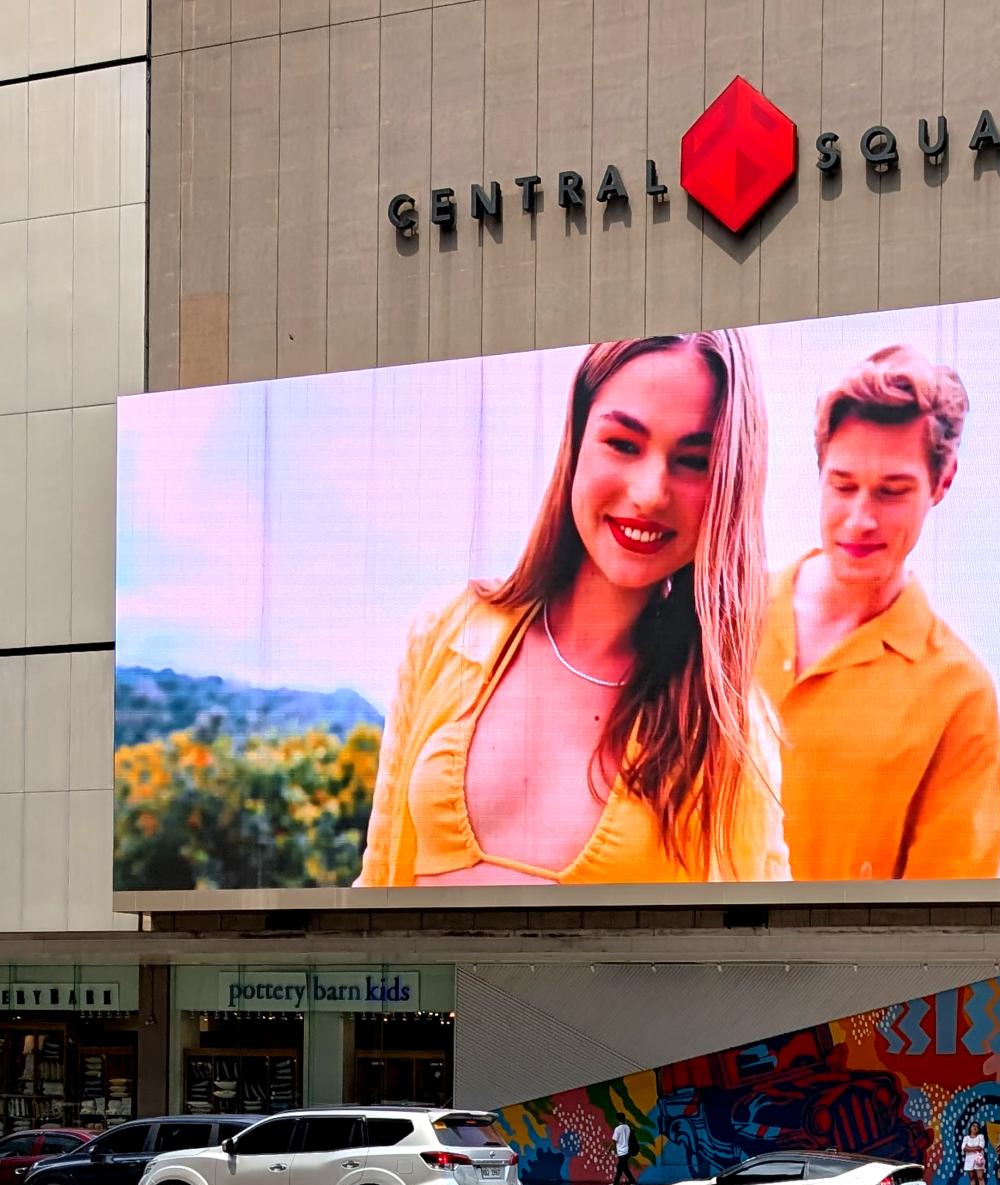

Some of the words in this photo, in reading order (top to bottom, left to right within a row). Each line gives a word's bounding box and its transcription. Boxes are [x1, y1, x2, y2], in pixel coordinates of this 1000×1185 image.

[388, 159, 668, 230] CENTRAL
[228, 982, 306, 1007] pottery
[313, 976, 361, 1001] barn
[365, 976, 410, 1001] kids
